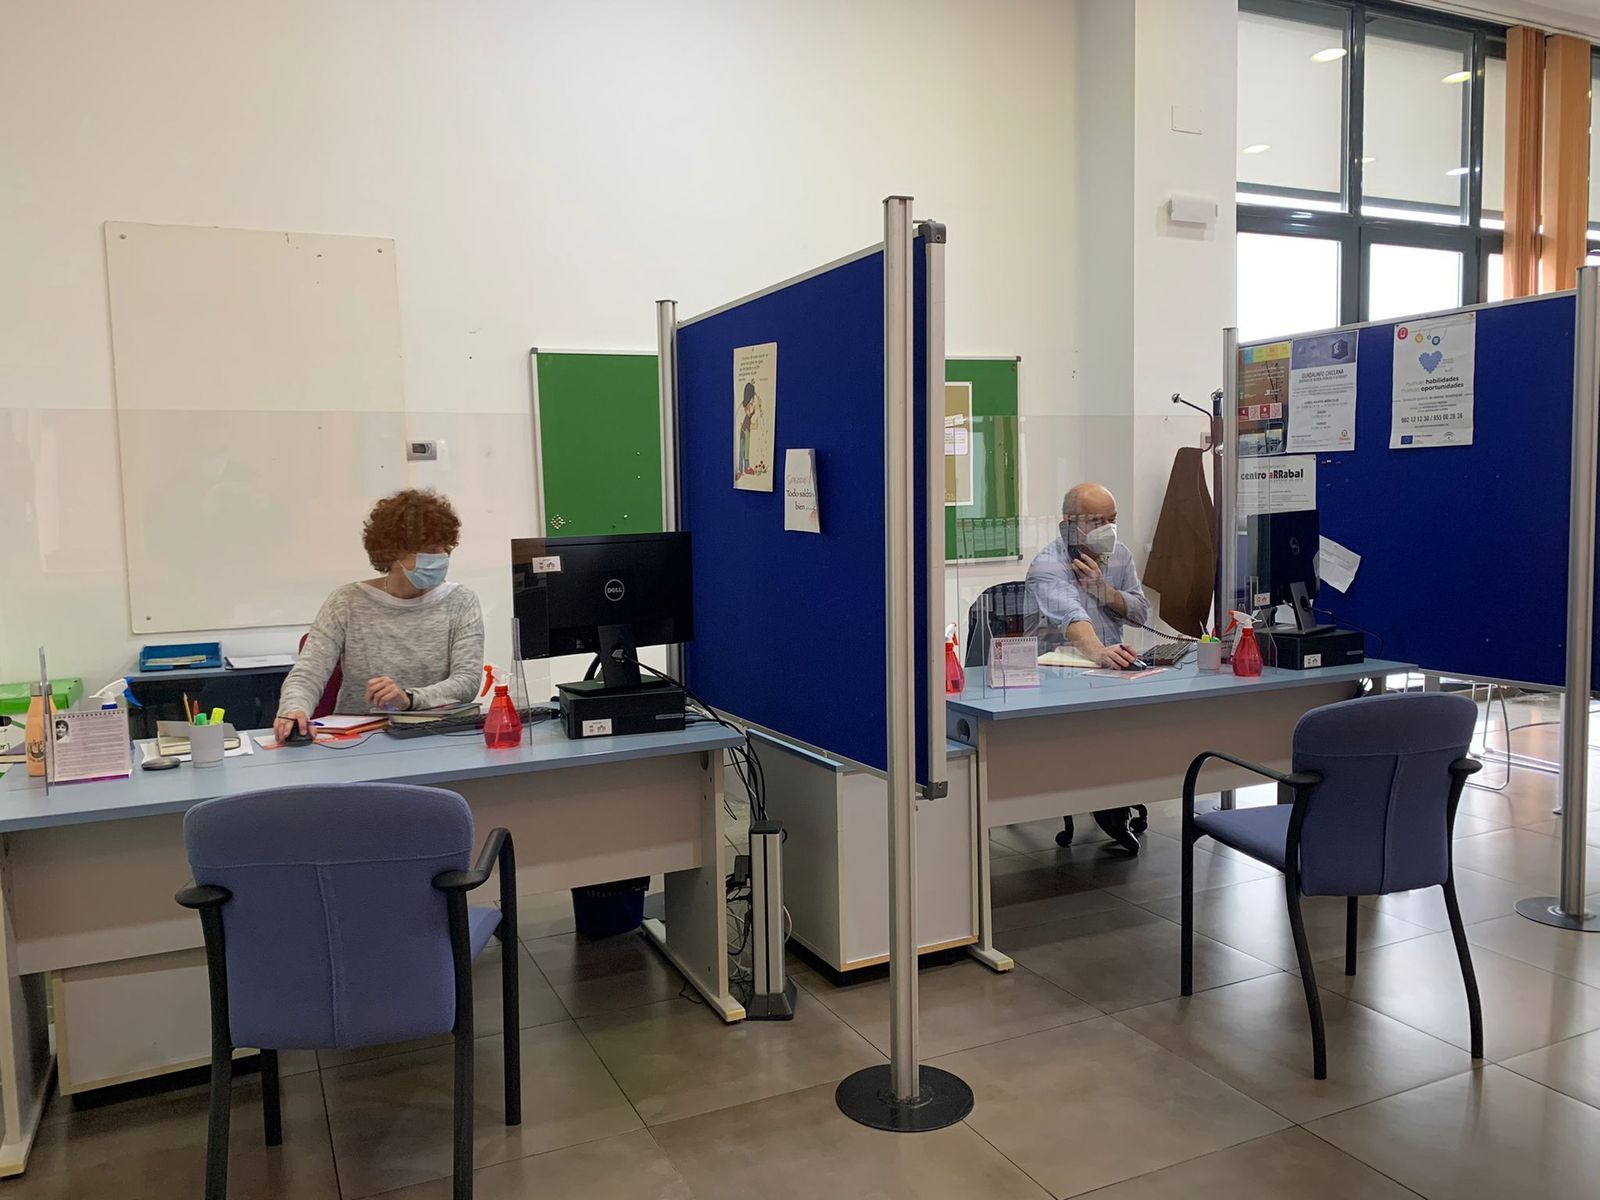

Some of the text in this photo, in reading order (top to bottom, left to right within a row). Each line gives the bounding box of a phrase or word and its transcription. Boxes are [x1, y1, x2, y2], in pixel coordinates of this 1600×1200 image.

[1425, 376, 1459, 385] habilidades
[1421, 382, 1464, 392] oportunidades
[1240, 468, 1304, 480] centro aRRabal
[786, 488, 799, 497] Todo
